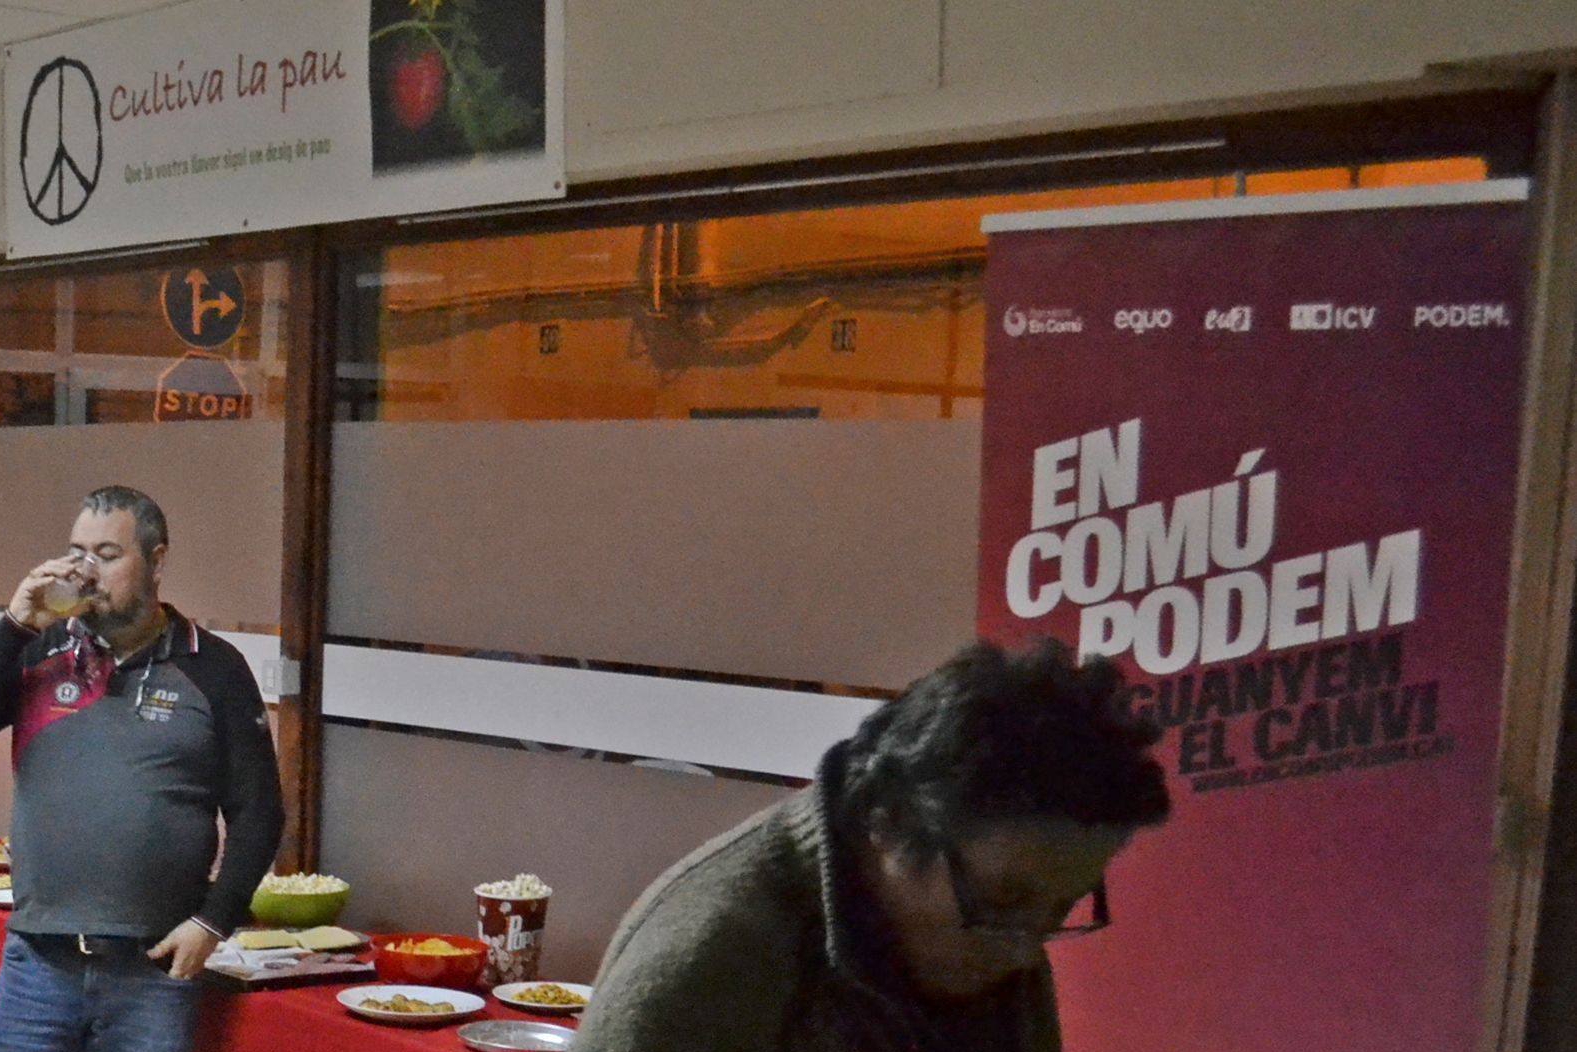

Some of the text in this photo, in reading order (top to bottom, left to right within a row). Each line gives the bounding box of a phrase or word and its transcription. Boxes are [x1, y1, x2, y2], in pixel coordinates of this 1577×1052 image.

[110, 50, 347, 121] Cultiva la pau
[1114, 308, 1172, 334] equo
[1336, 306, 1375, 329] ICV
[163, 389, 238, 418] STOP
[1030, 417, 1142, 530] EN
[1005, 448, 1278, 618] COMÚ
[1078, 528, 1421, 675] PODEM
[1122, 632, 1403, 728] GUANYEM
[1179, 720, 1236, 775] EL
[1253, 680, 1440, 762] CANVI
